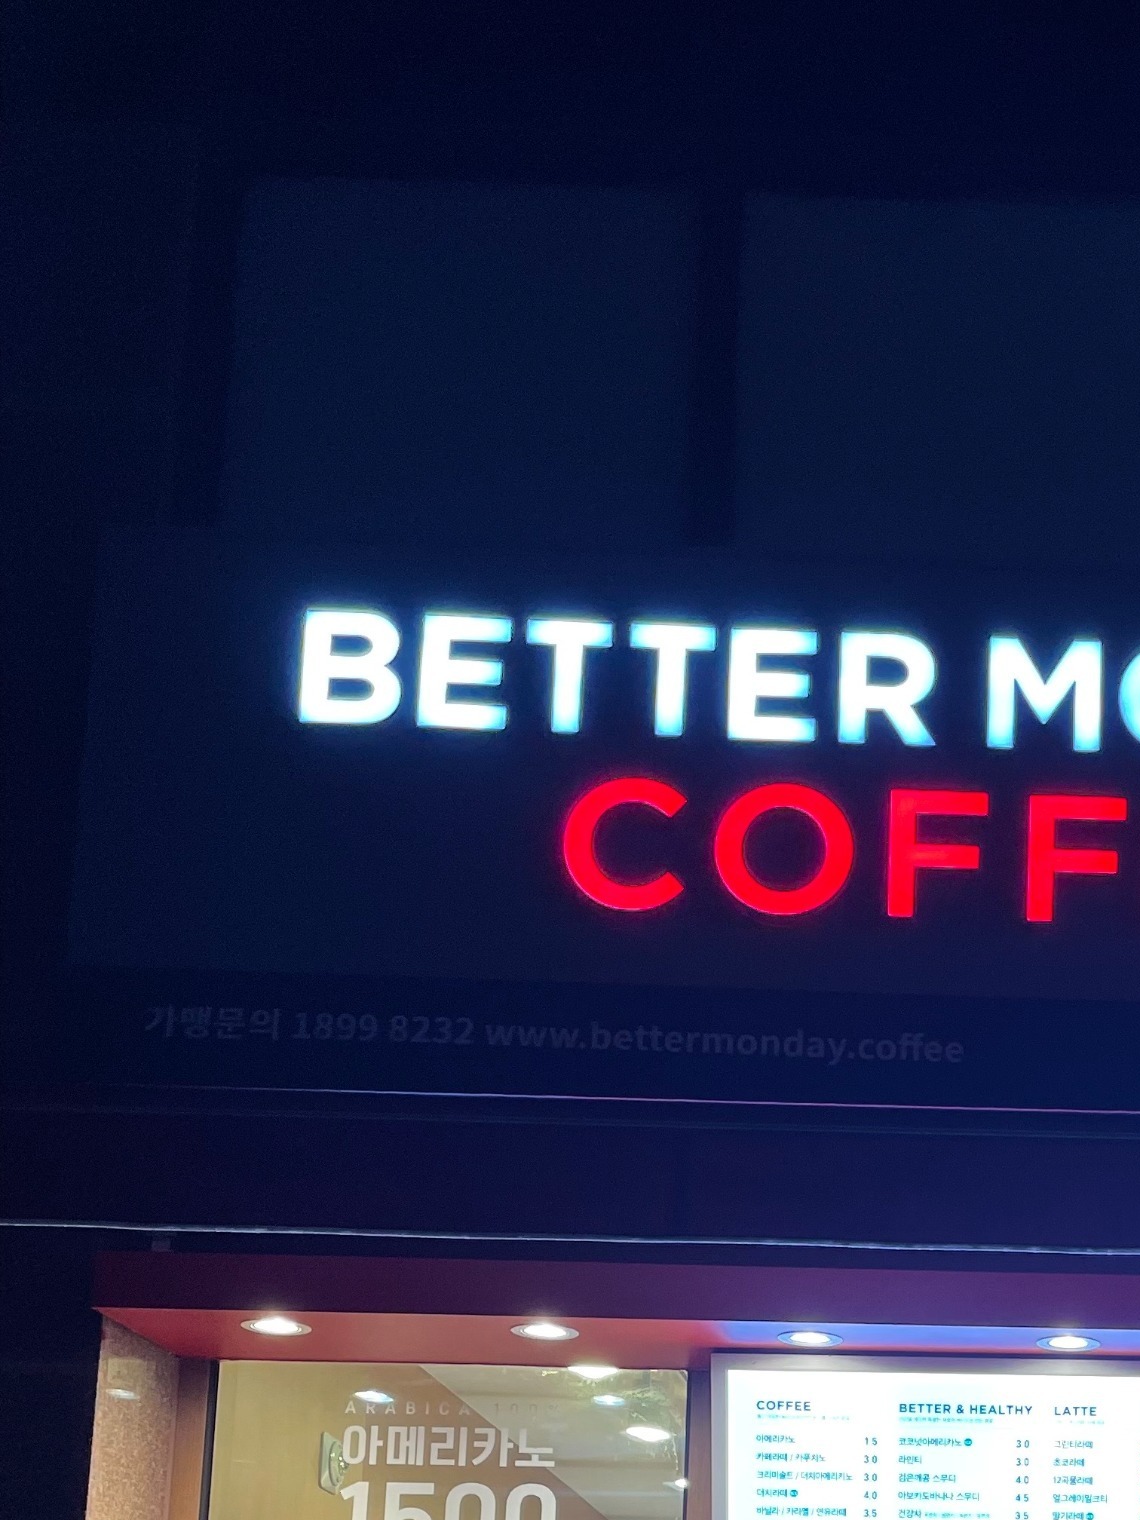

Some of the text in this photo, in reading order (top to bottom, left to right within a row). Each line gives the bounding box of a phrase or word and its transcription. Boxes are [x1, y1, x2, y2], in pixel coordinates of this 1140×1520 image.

[299, 607, 936, 747] BETTER
[142, 1006, 965, 1066] 가맹문의 1899 8232 www.bettermonday.coffee
[345, 1400, 471, 1416] ARABICA
[756, 1401, 810, 1411] COFFEE
[900, 1404, 1032, 1414] BETTER & HEALTHY
[1055, 1407, 1096, 1416] LATTE
[342, 1424, 556, 1467] 아메리카노
[864, 1509, 877, 1517] 3.5
